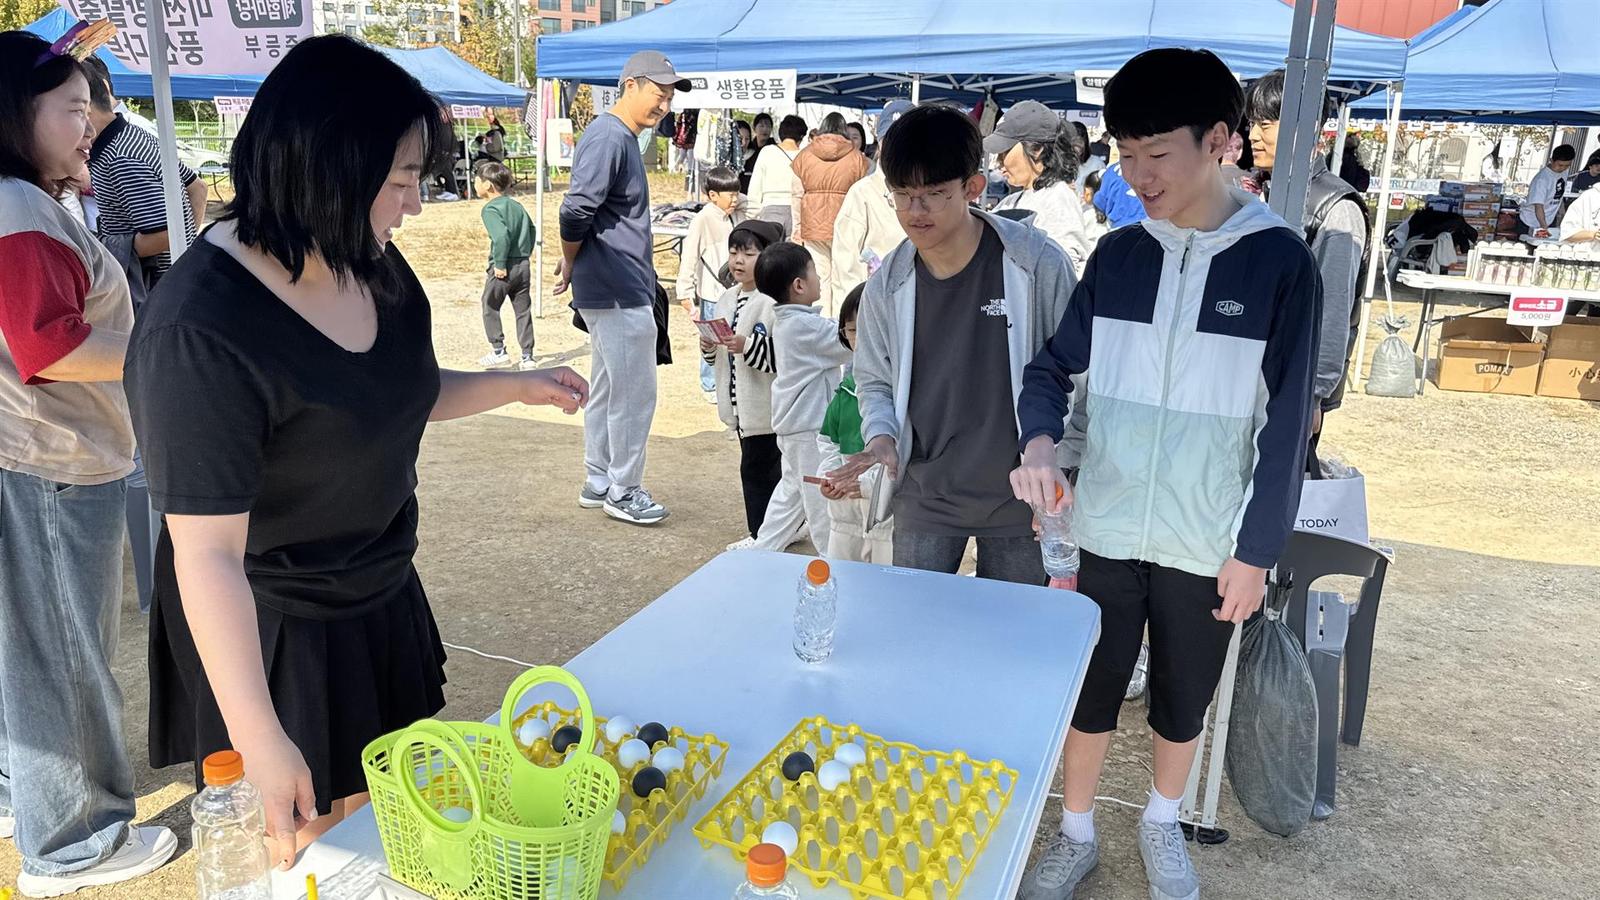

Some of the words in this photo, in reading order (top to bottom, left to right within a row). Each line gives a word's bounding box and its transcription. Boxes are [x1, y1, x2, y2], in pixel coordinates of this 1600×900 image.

[716, 78, 786, 100] 생활용품
[1218, 302, 1241, 313] CAMP
[1520, 312, 1551, 321] 5,000원
[1300, 518, 1339, 528] TODAY
